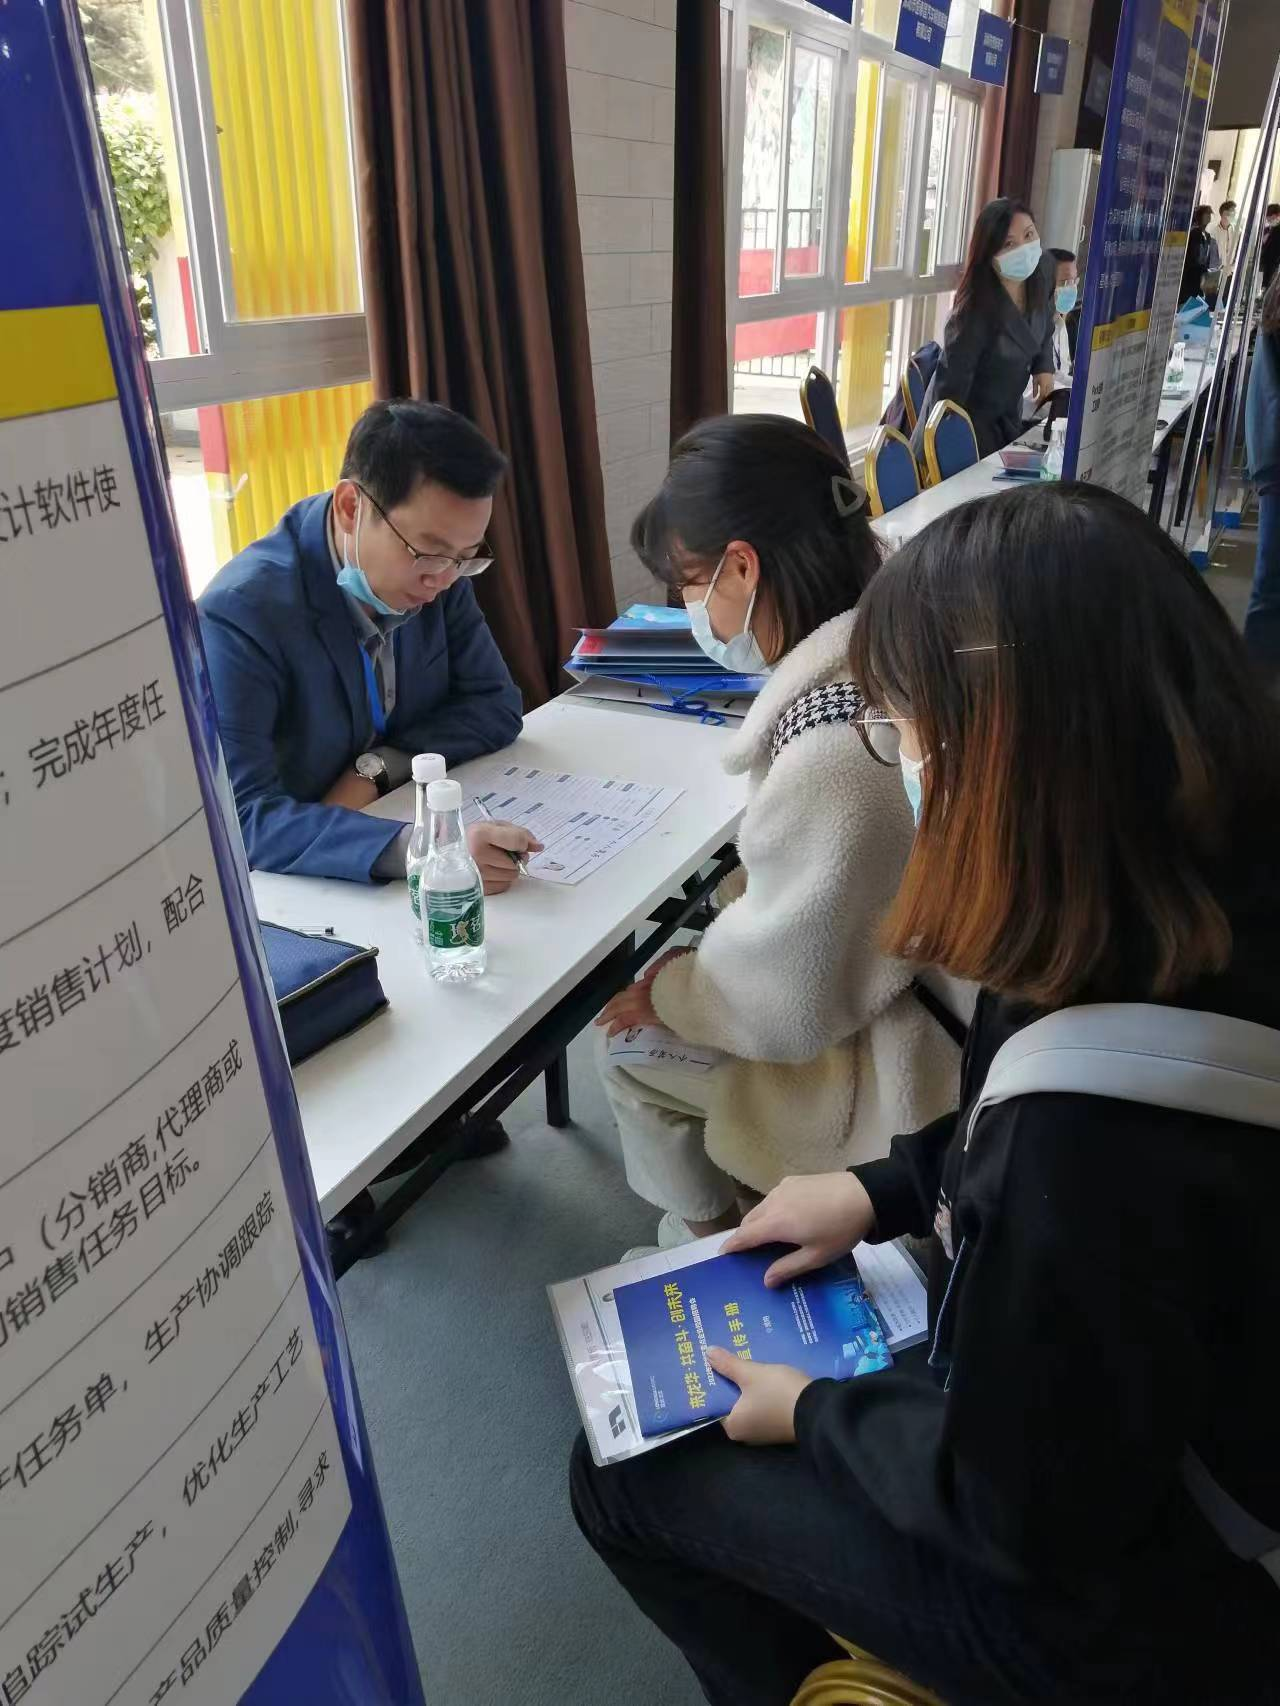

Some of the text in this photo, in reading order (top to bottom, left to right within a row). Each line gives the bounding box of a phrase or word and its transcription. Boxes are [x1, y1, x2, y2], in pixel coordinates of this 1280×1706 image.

[0, 464, 121, 542] 计软件使
[0, 1148, 200, 1348] 销售任务目标。
[0, 1189, 275, 1490] 任务单，生产协调跟踪
